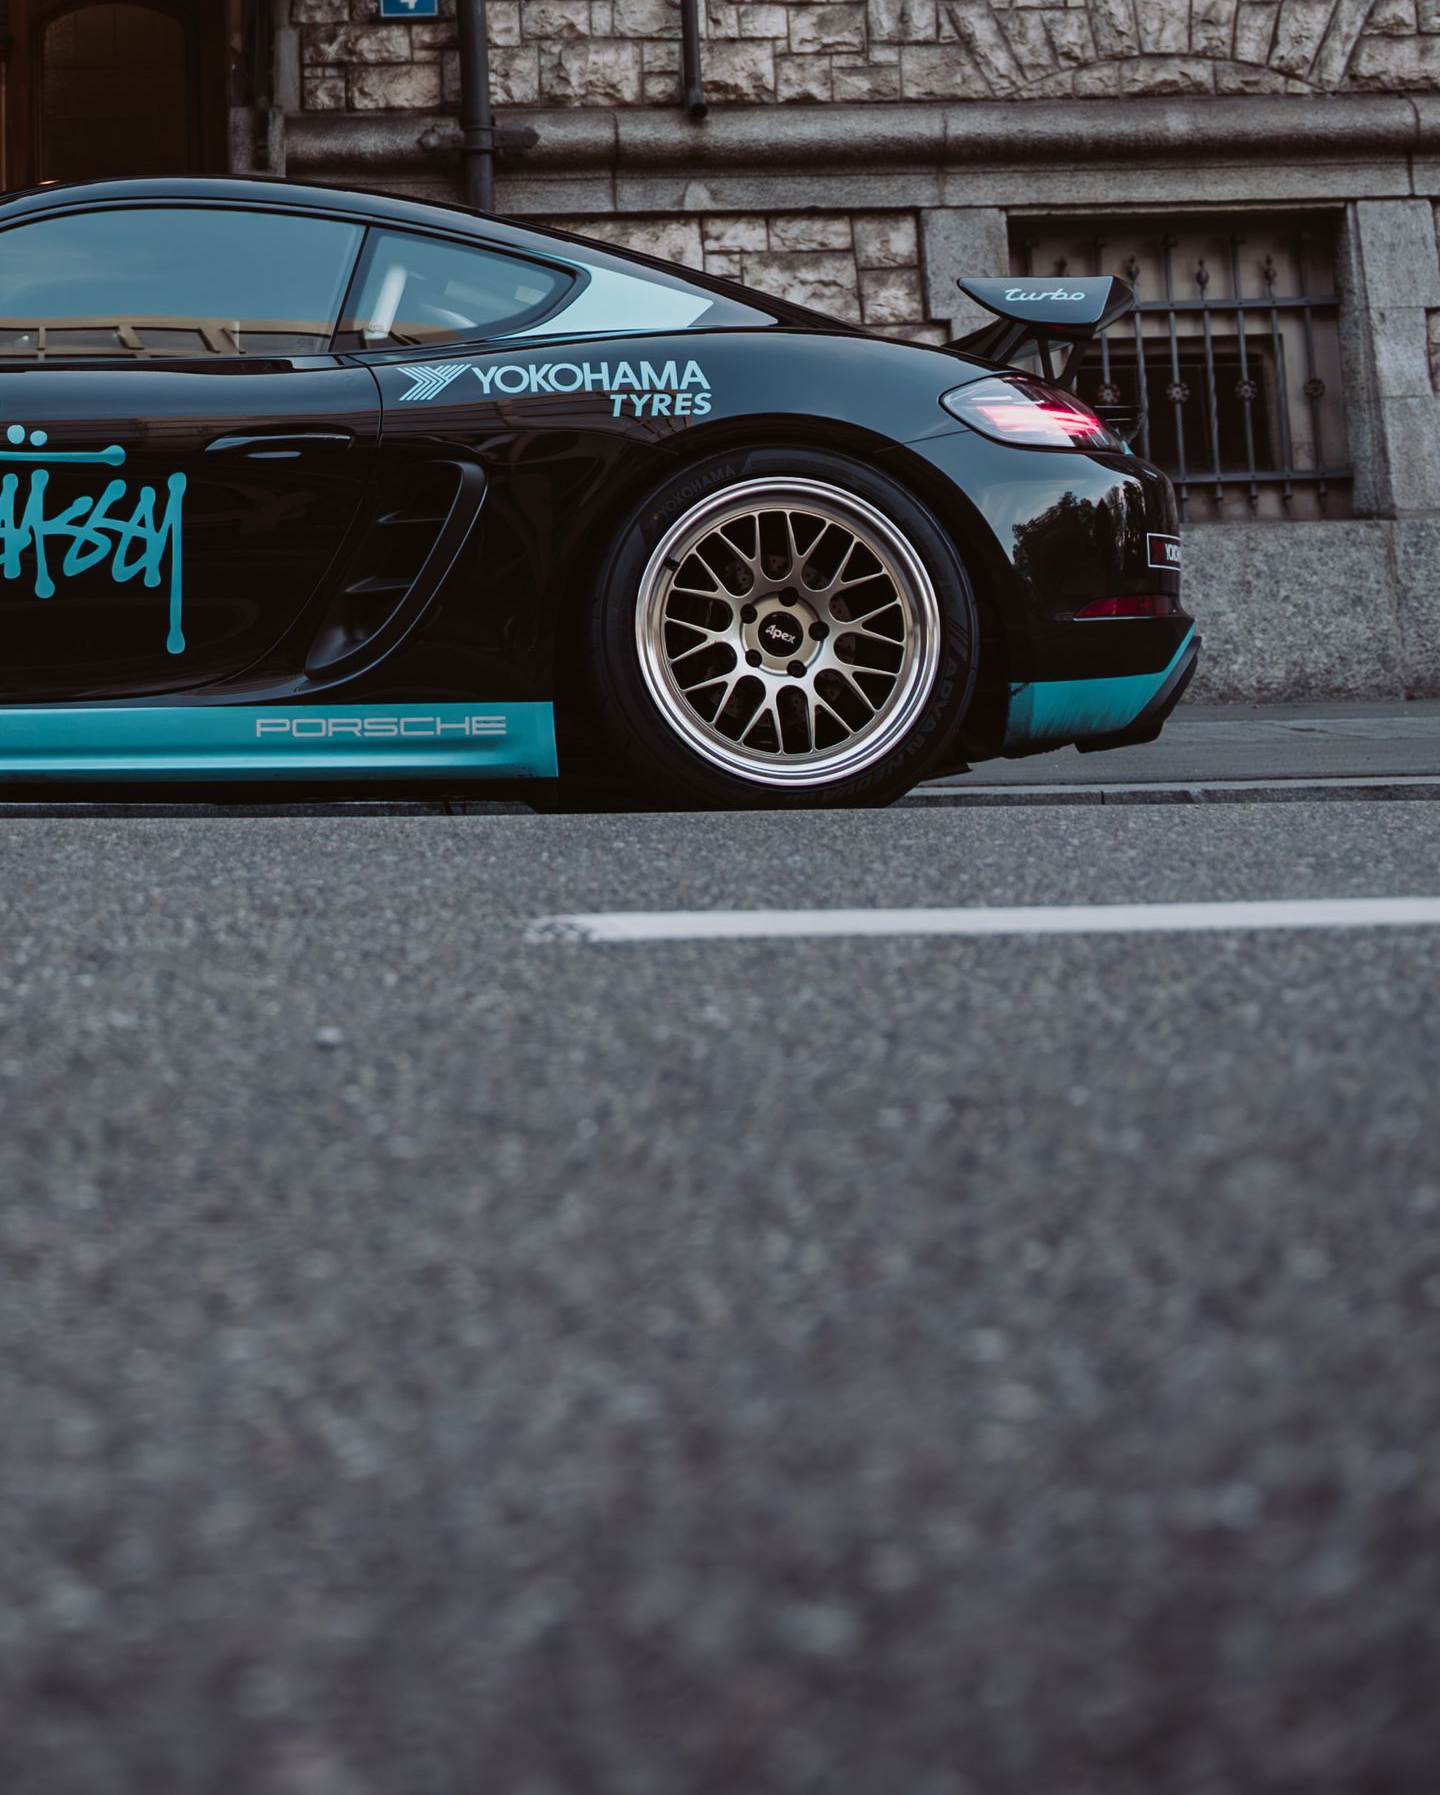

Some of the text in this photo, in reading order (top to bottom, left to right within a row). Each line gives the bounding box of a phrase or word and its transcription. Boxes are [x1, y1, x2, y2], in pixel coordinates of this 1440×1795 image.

[1004, 287, 1086, 302] turbo
[471, 360, 711, 395] YOKOHAMA
[610, 392, 712, 418] TYRES
[659, 463, 737, 518] YOKOHAMA
[765, 624, 796, 644] Apex
[255, 715, 508, 739] PORSCHE
